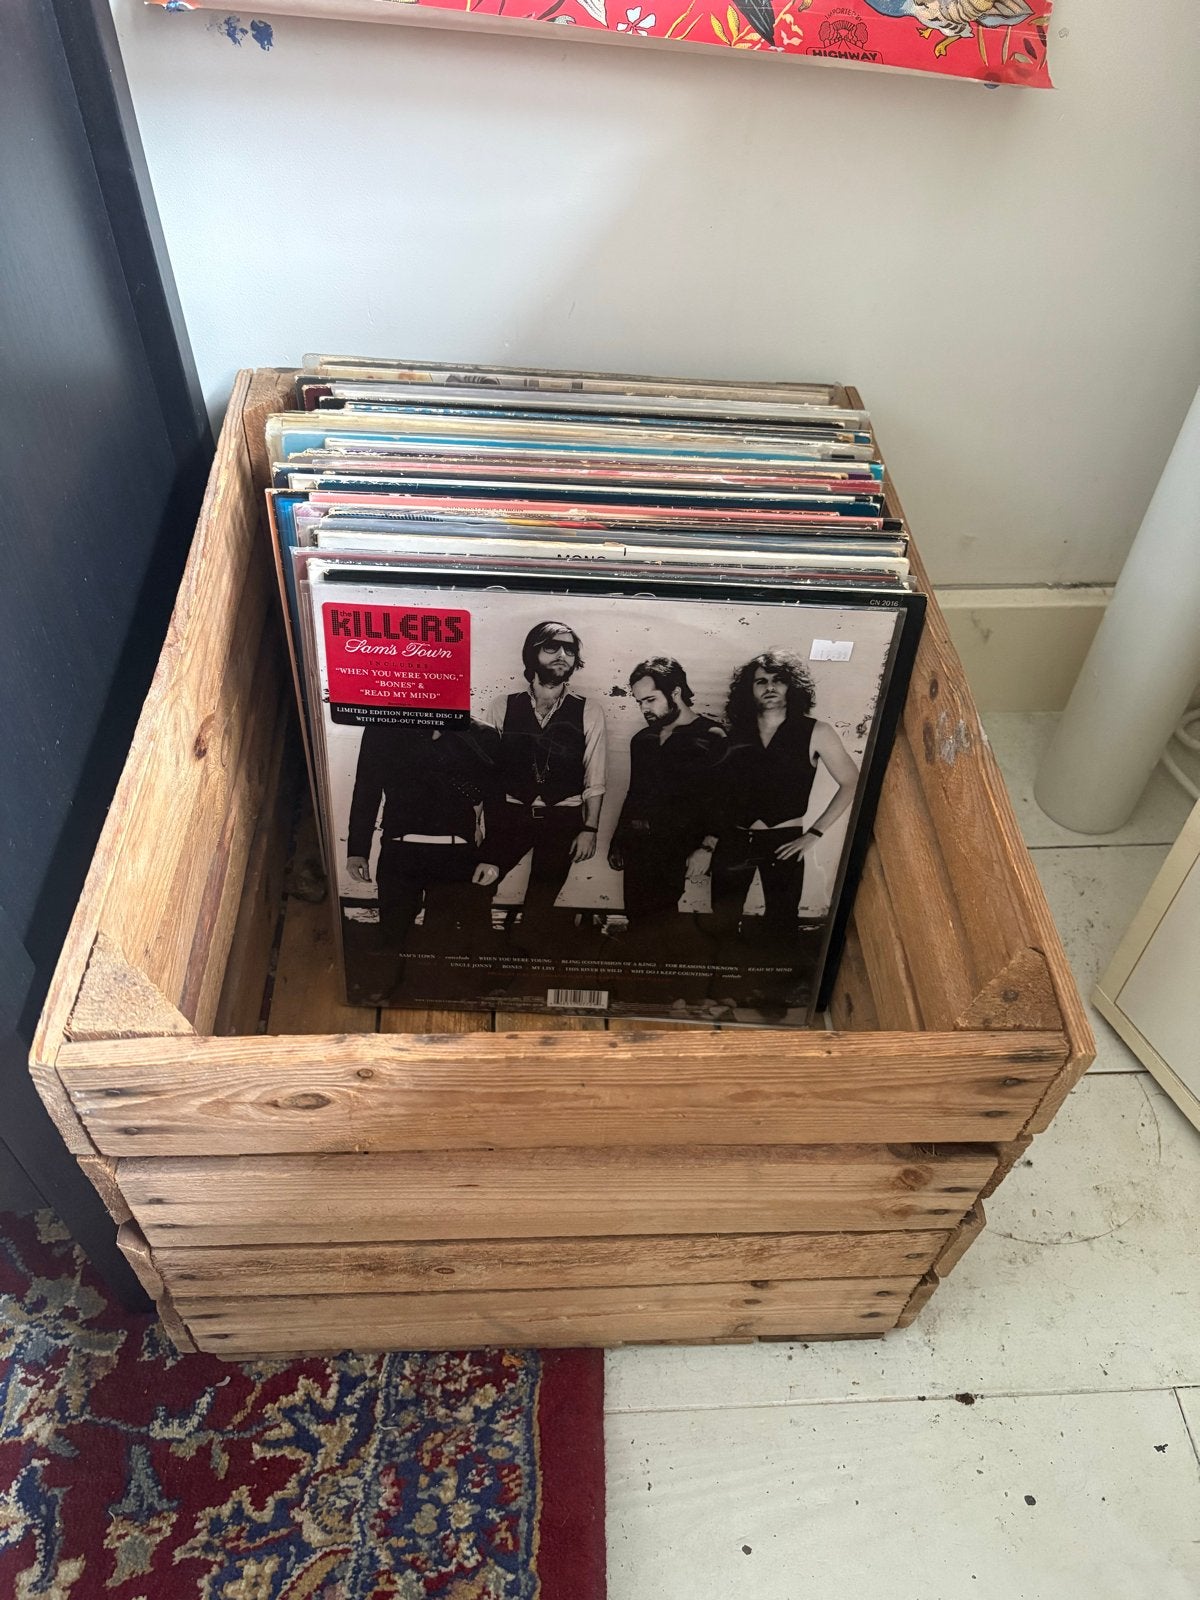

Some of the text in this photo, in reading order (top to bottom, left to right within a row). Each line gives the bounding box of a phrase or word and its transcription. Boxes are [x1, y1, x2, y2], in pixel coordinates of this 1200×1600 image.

[812, 49, 878, 61] HIGHWAY
[339, 610, 352, 618] the
[330, 609, 464, 643] KILLERS
[344, 639, 453, 659] Sam's Town
[370, 669, 392, 677] YOU
[393, 671, 422, 679] WERE
[393, 691, 408, 699] MY
[336, 706, 368, 715] LIMITED
[369, 708, 401, 716] EDITION
[402, 710, 434, 718] PICTURE
[356, 715, 375, 723] WITH
[376, 717, 415, 725] FOLD-OUT
